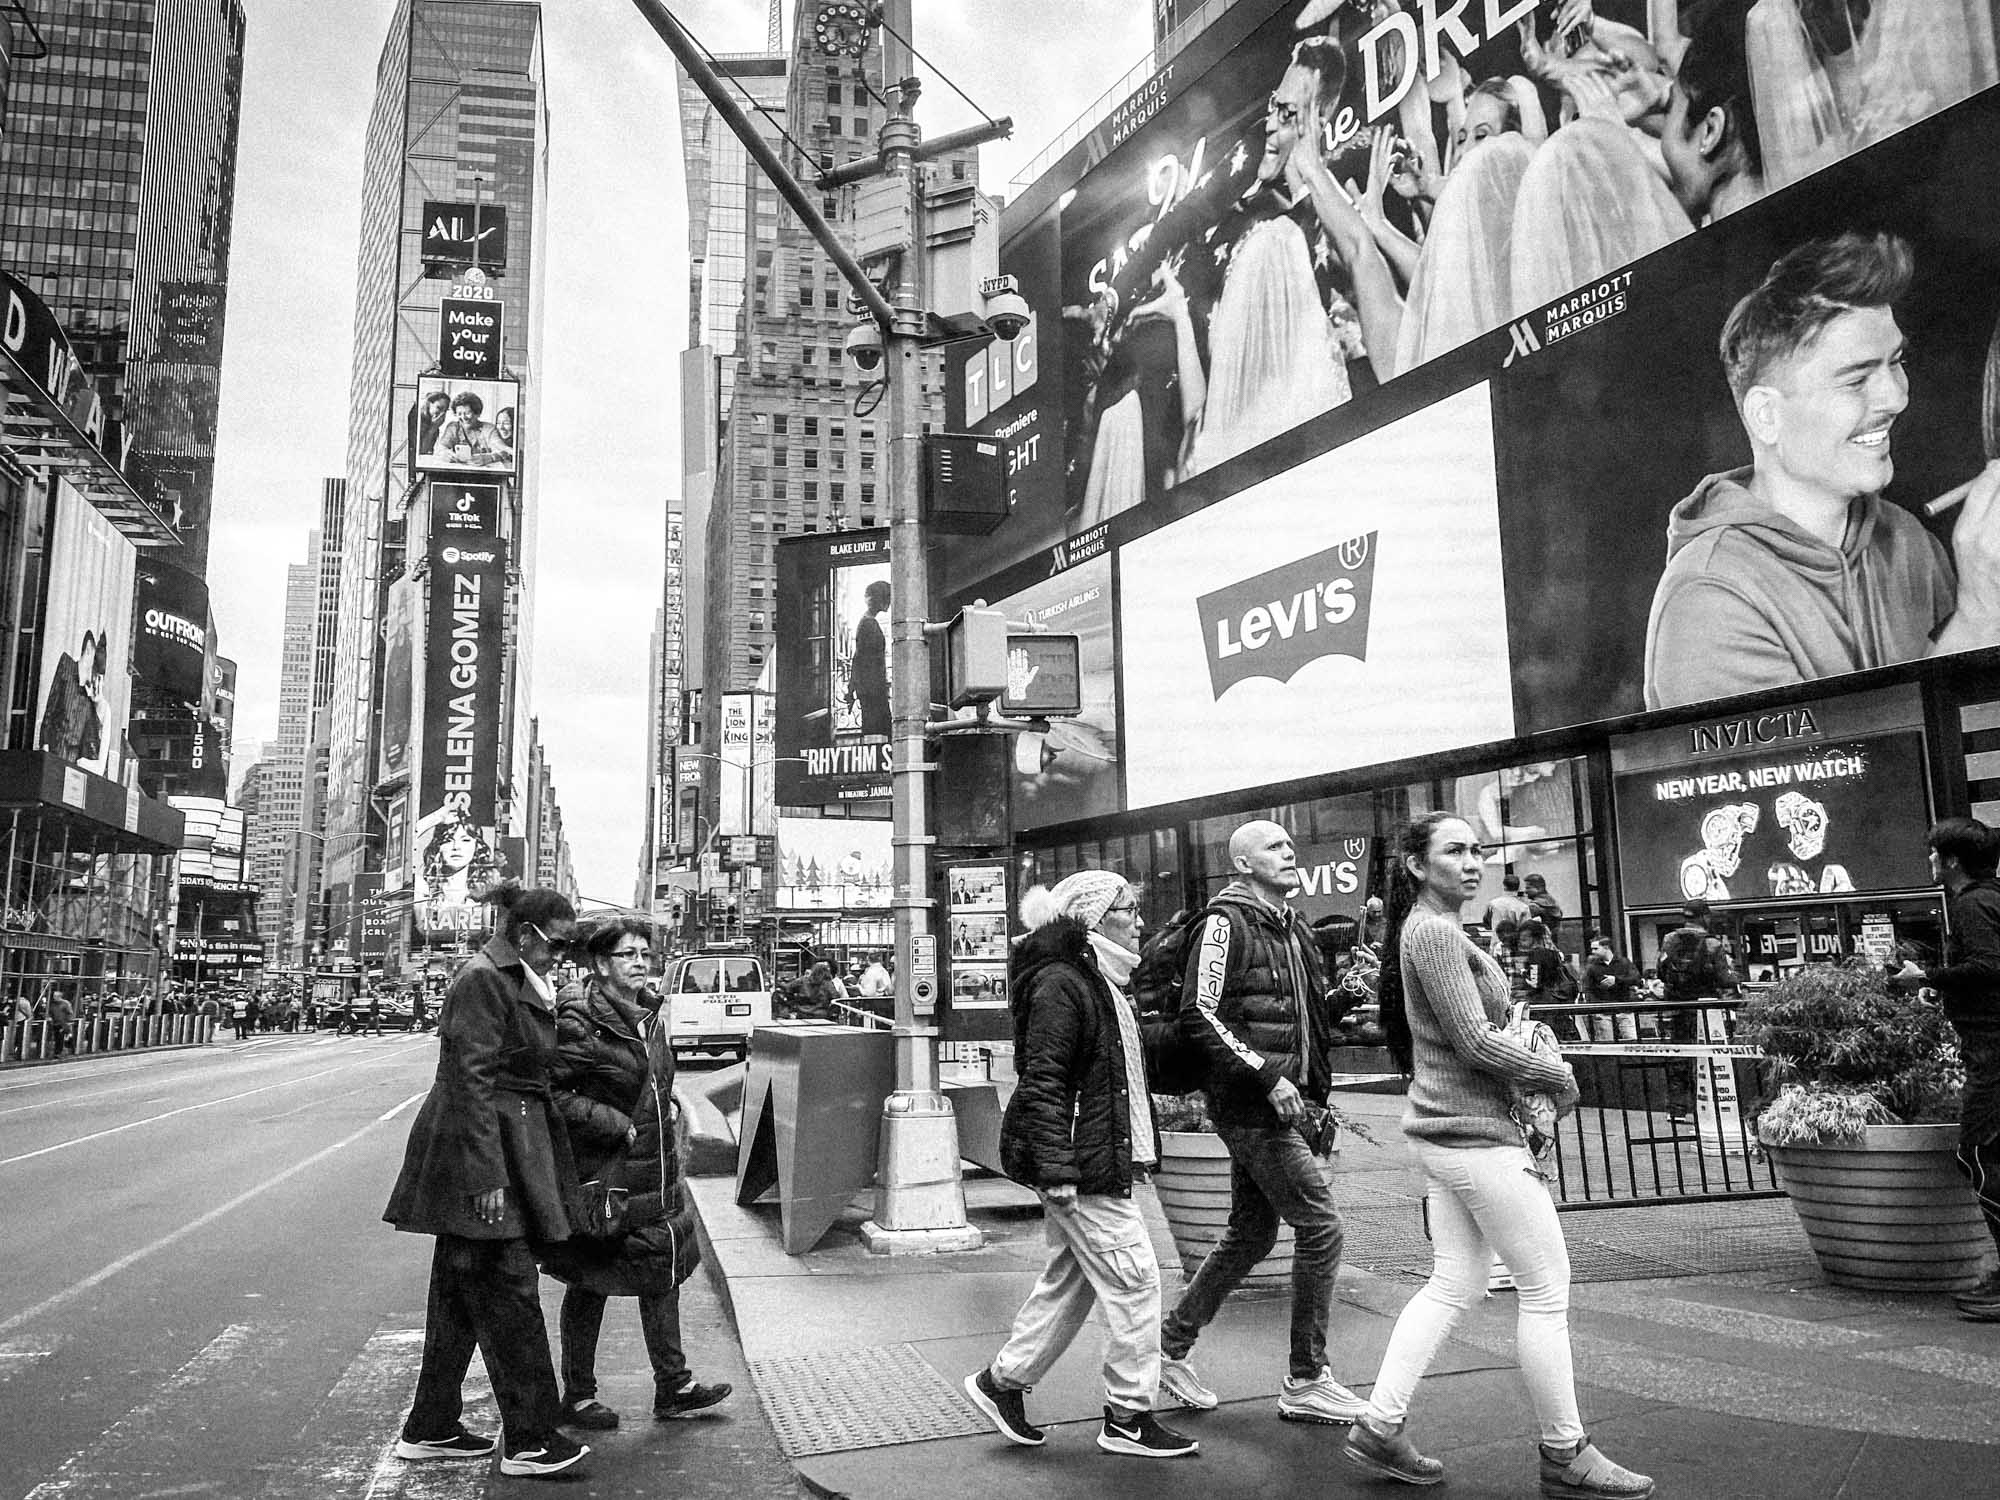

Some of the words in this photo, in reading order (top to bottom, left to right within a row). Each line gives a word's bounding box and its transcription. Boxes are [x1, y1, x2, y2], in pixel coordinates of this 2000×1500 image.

[1112, 64, 1175, 128] MARRIOTT
[1112, 91, 1168, 146] MARQUIS
[453, 285, 494, 299] 2020
[983, 276, 1009, 292] NYPD
[1546, 271, 1633, 323] MARRIOTT
[448, 310, 495, 327] Make
[1548, 296, 1625, 342] MARQUIS
[451, 328, 490, 346] your
[453, 346, 487, 365] day.
[968, 335, 1032, 407] TLC
[994, 409, 1038, 439] Premiere
[448, 512, 481, 523] TikTok
[830, 543, 853, 555] BLAKE
[854, 541, 877, 553] LIVELY
[1069, 524, 1109, 551] MARRIOTT
[1070, 539, 1105, 563] MARQUIS
[460, 551, 496, 564] Spotify
[1038, 601, 1068, 621] TURKISH
[1068, 587, 1100, 609] AIRLINES
[145, 609, 205, 647] OUTFRONT
[449, 573, 481, 689] GOMEZ
[728, 707, 743, 716] THE
[191, 722, 204, 769] 1500
[723, 729, 749, 745] KING
[1689, 708, 1821, 754] INVICTA
[443, 692, 477, 813] SELENA
[679, 759, 700, 771] NEW
[808, 745, 877, 775] RHYTHM
[1656, 777, 1695, 801] NEW
[1696, 771, 1748, 795] YEAR,
[1749, 765, 1791, 789] NEW
[1795, 756, 1864, 782] WATCH
